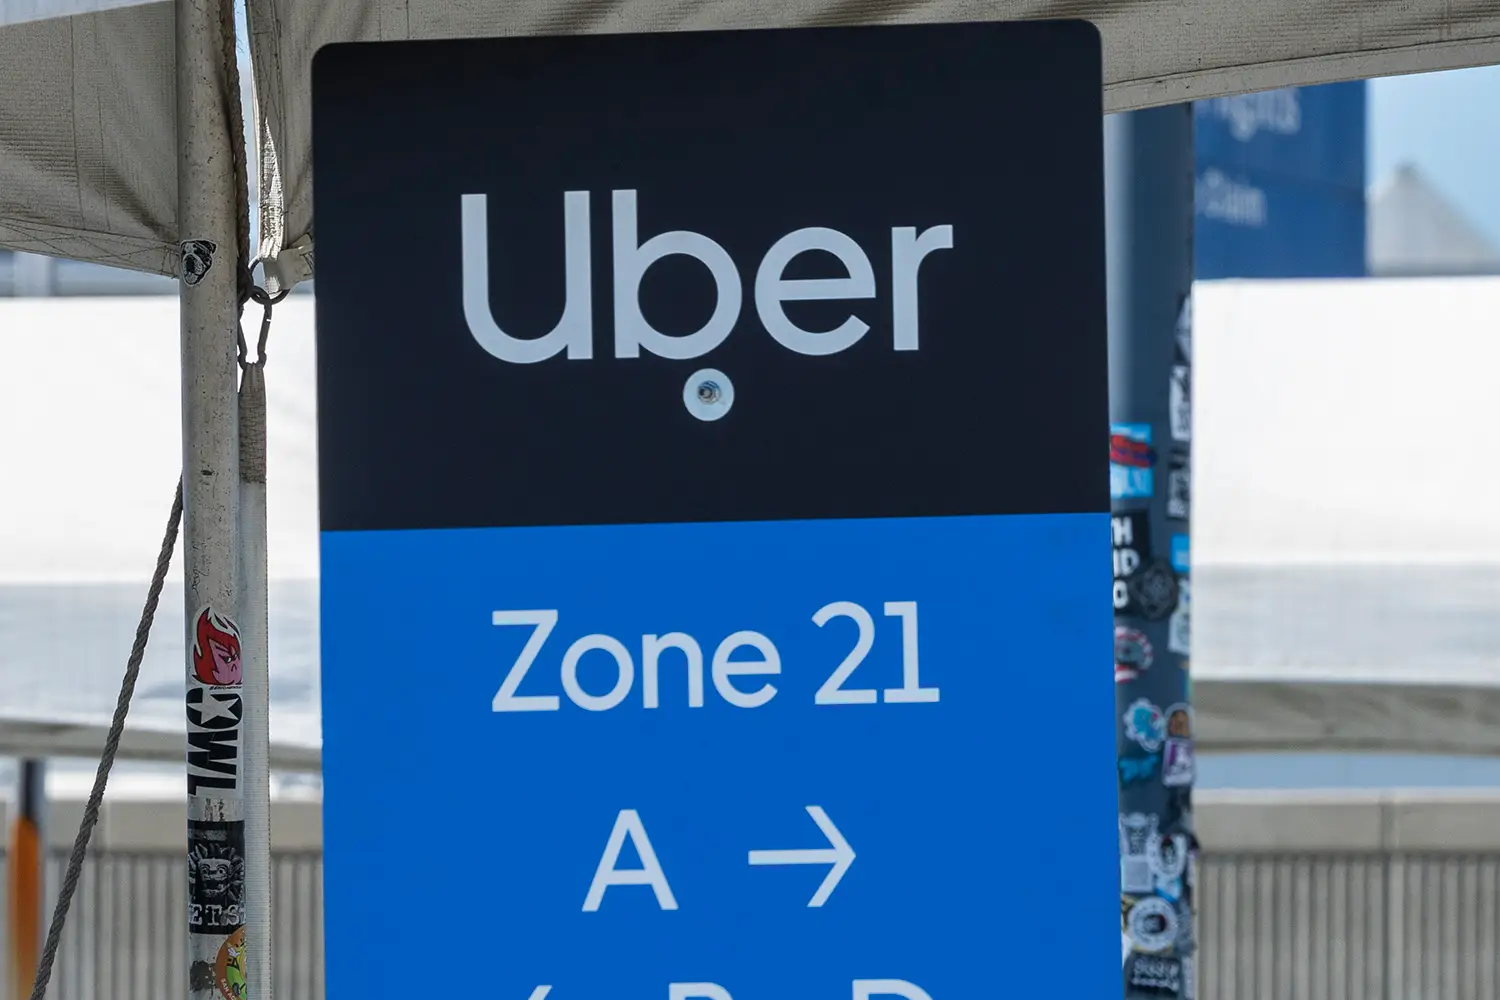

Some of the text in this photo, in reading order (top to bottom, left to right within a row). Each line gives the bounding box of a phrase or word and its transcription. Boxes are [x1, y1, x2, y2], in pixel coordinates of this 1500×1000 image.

[461, 188, 954, 364] Uber
[491, 601, 940, 713] Zone 21
[581, 809, 678, 912] A
